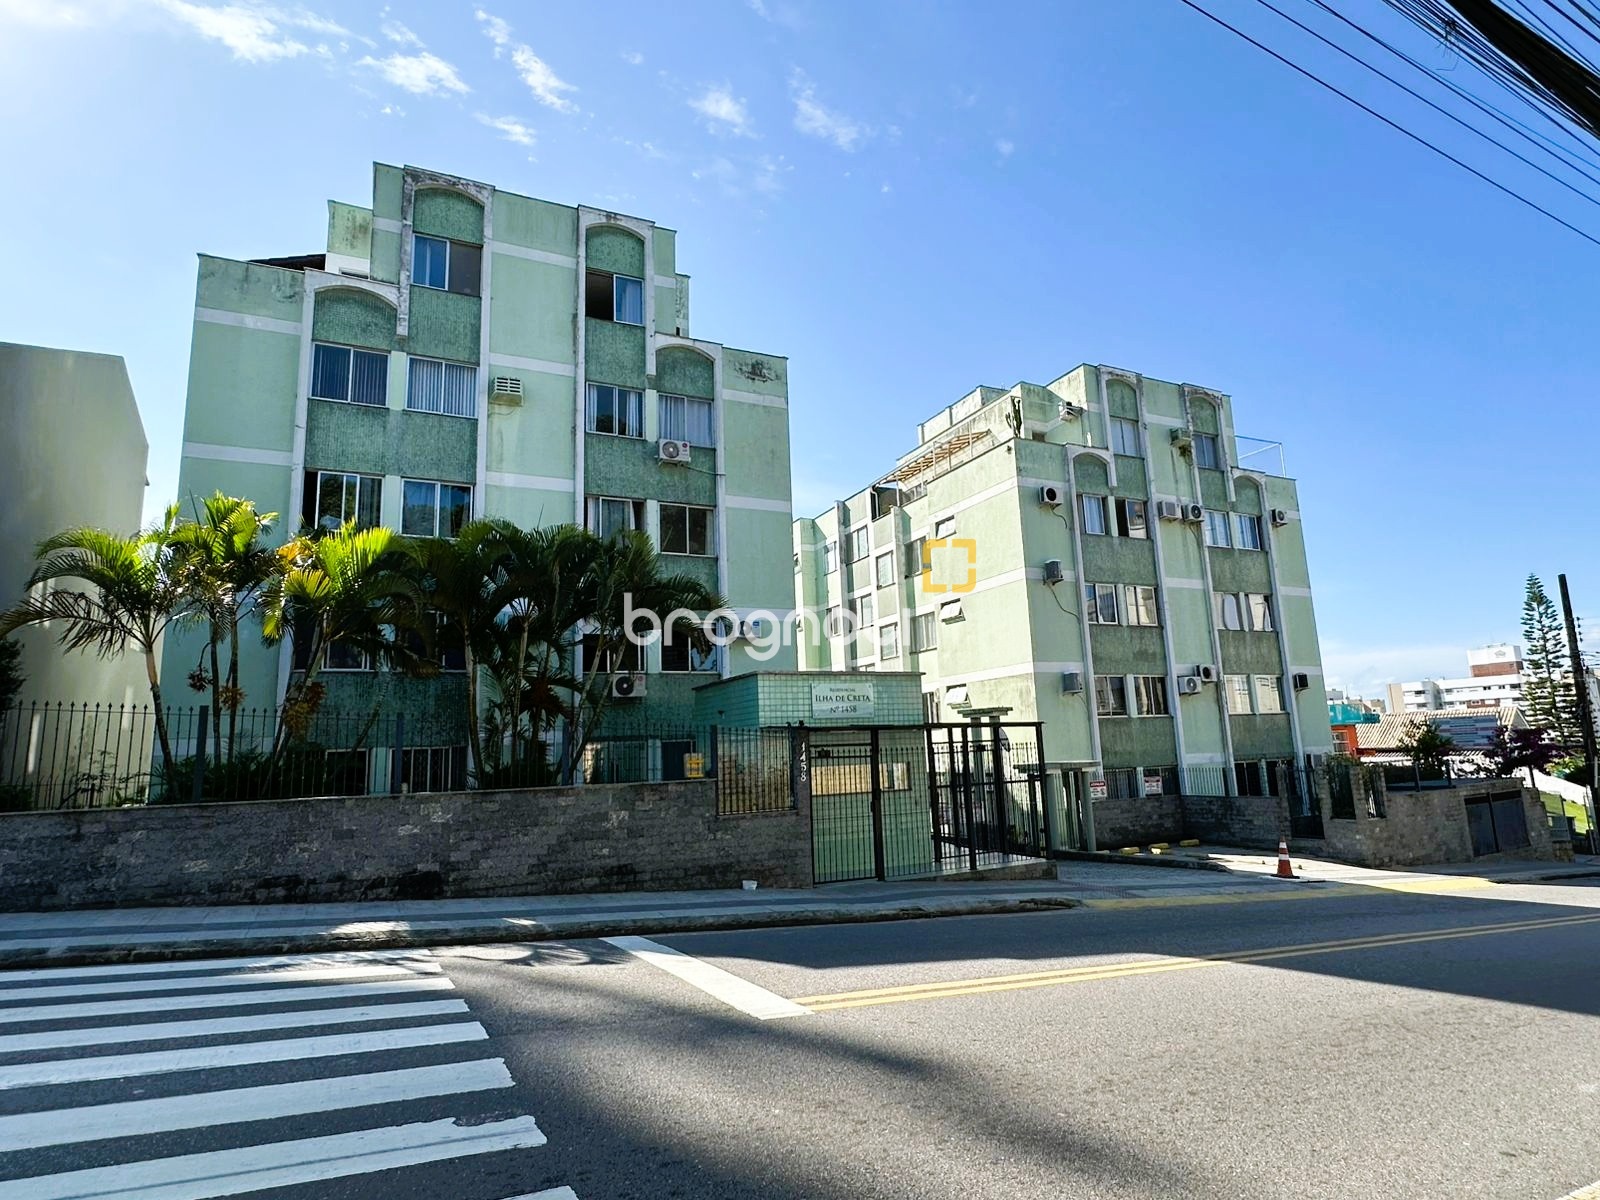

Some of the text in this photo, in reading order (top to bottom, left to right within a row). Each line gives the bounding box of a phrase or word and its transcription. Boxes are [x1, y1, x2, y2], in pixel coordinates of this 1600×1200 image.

[815, 694, 833, 702] ILHA
[846, 693, 871, 702] CRETA
[841, 704, 857, 713] 1458
